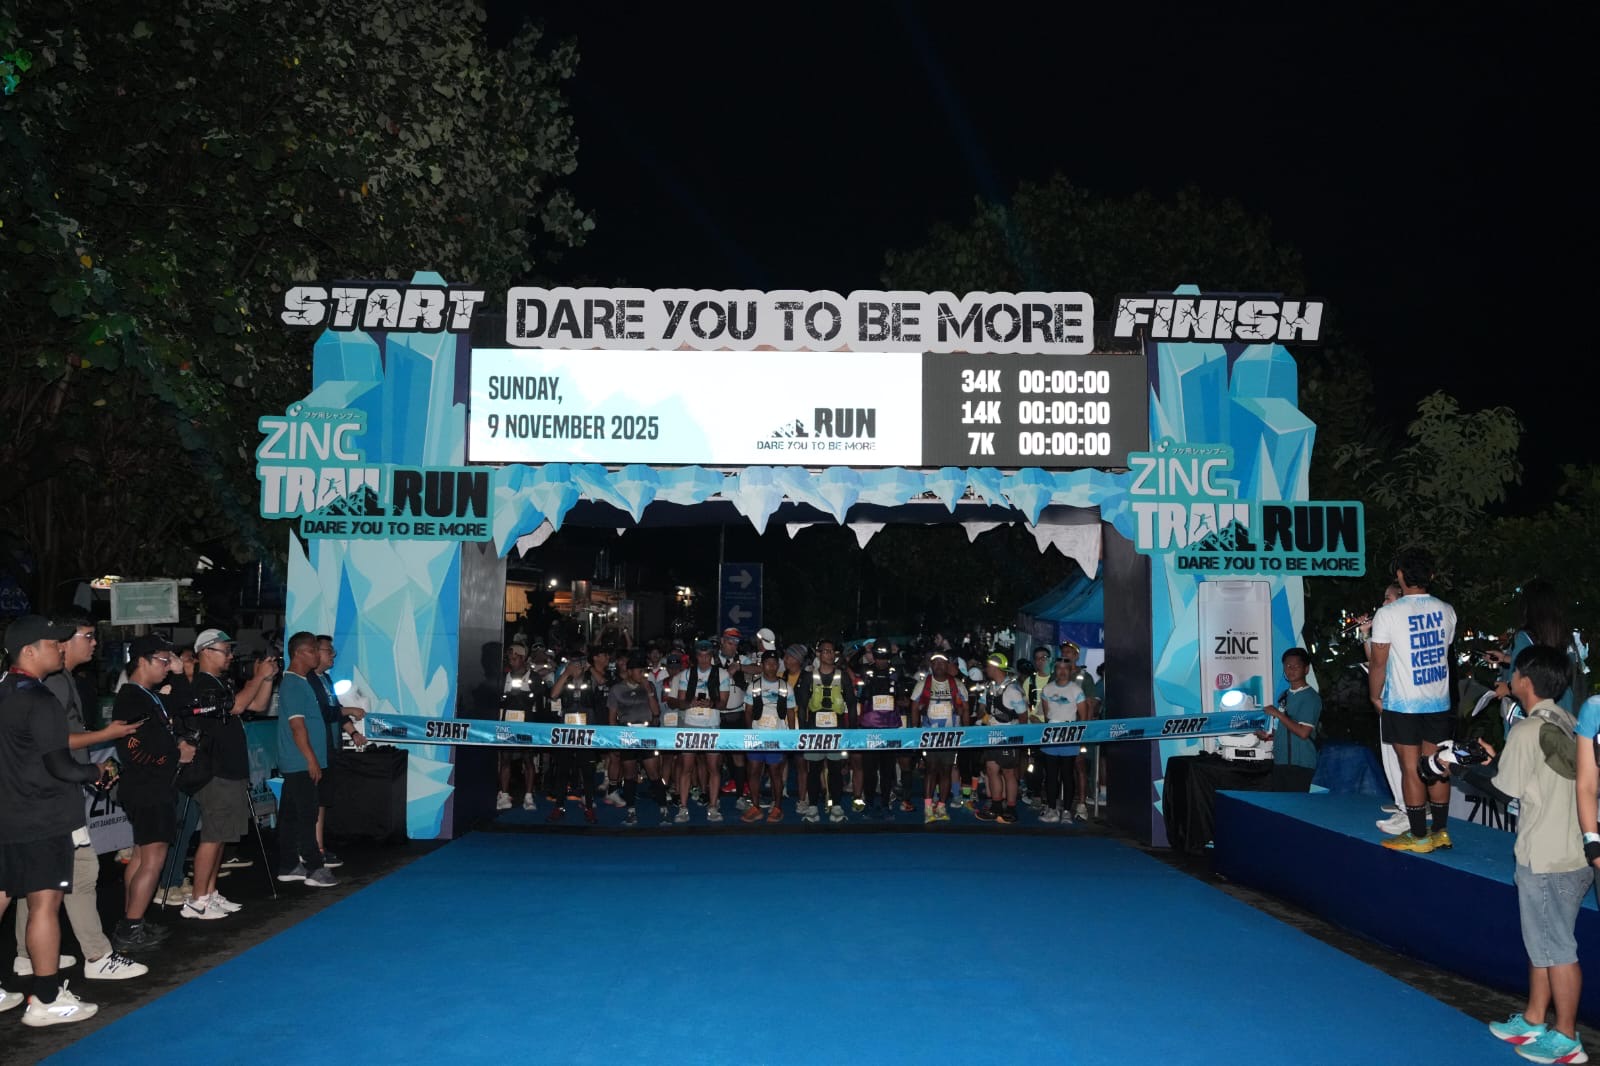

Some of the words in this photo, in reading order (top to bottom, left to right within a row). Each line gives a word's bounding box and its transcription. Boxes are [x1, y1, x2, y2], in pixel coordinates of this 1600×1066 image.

[281, 286, 485, 329] START
[516, 298, 645, 339] DARE
[662, 300, 757, 341] YOU
[774, 301, 842, 342] TO
[858, 301, 921, 342] BE
[937, 302, 1084, 343] MORE
[1114, 298, 1323, 341] FINISH
[488, 375, 563, 405] SUNDAY,
[961, 369, 1002, 393] 34K
[1018, 369, 1110, 394] 00:00:00
[814, 407, 876, 438] RUN
[961, 400, 1002, 424] 14K
[1018, 400, 1111, 425] 00:00:00
[487, 413, 499, 438] 9
[505, 414, 605, 439] NOVEMBER
[611, 415, 659, 440] 2025
[259, 421, 361, 461] ZINC
[756, 440, 784, 450] DARE
[787, 441, 808, 450] YOU
[812, 441, 826, 451] TO
[828, 441, 841, 451] BE
[844, 441, 876, 451] MORE
[967, 432, 996, 455] 7K
[1018, 431, 1111, 456] 00:00:00
[1130, 457, 1228, 497] ZINC
[259, 466, 385, 516] TRAIL
[392, 469, 489, 518] RUN
[304, 519, 347, 534] DARE
[351, 520, 383, 535] YOU
[387, 521, 410, 535] TO
[413, 521, 435, 536] BE
[438, 522, 488, 537] MORE
[1132, 502, 1257, 552] TRAIL
[1262, 505, 1359, 553] RUN
[1177, 555, 1220, 570] DARE
[1223, 556, 1256, 571] YOU
[1259, 557, 1282, 571] TO
[1285, 557, 1308, 571] BE
[1311, 557, 1360, 571] MORE
[1407, 610, 1444, 632] STAY
[1214, 636, 1259, 655] ZINC
[1409, 630, 1444, 650] COOL
[1410, 646, 1445, 668] KEEP
[1412, 665, 1448, 686] GOING
[425, 720, 471, 739] START
[551, 727, 595, 746] START
[1040, 724, 1088, 744] START
[1161, 717, 1208, 735] START
[675, 731, 720, 749] START
[797, 732, 842, 750] START
[919, 731, 964, 749] START
